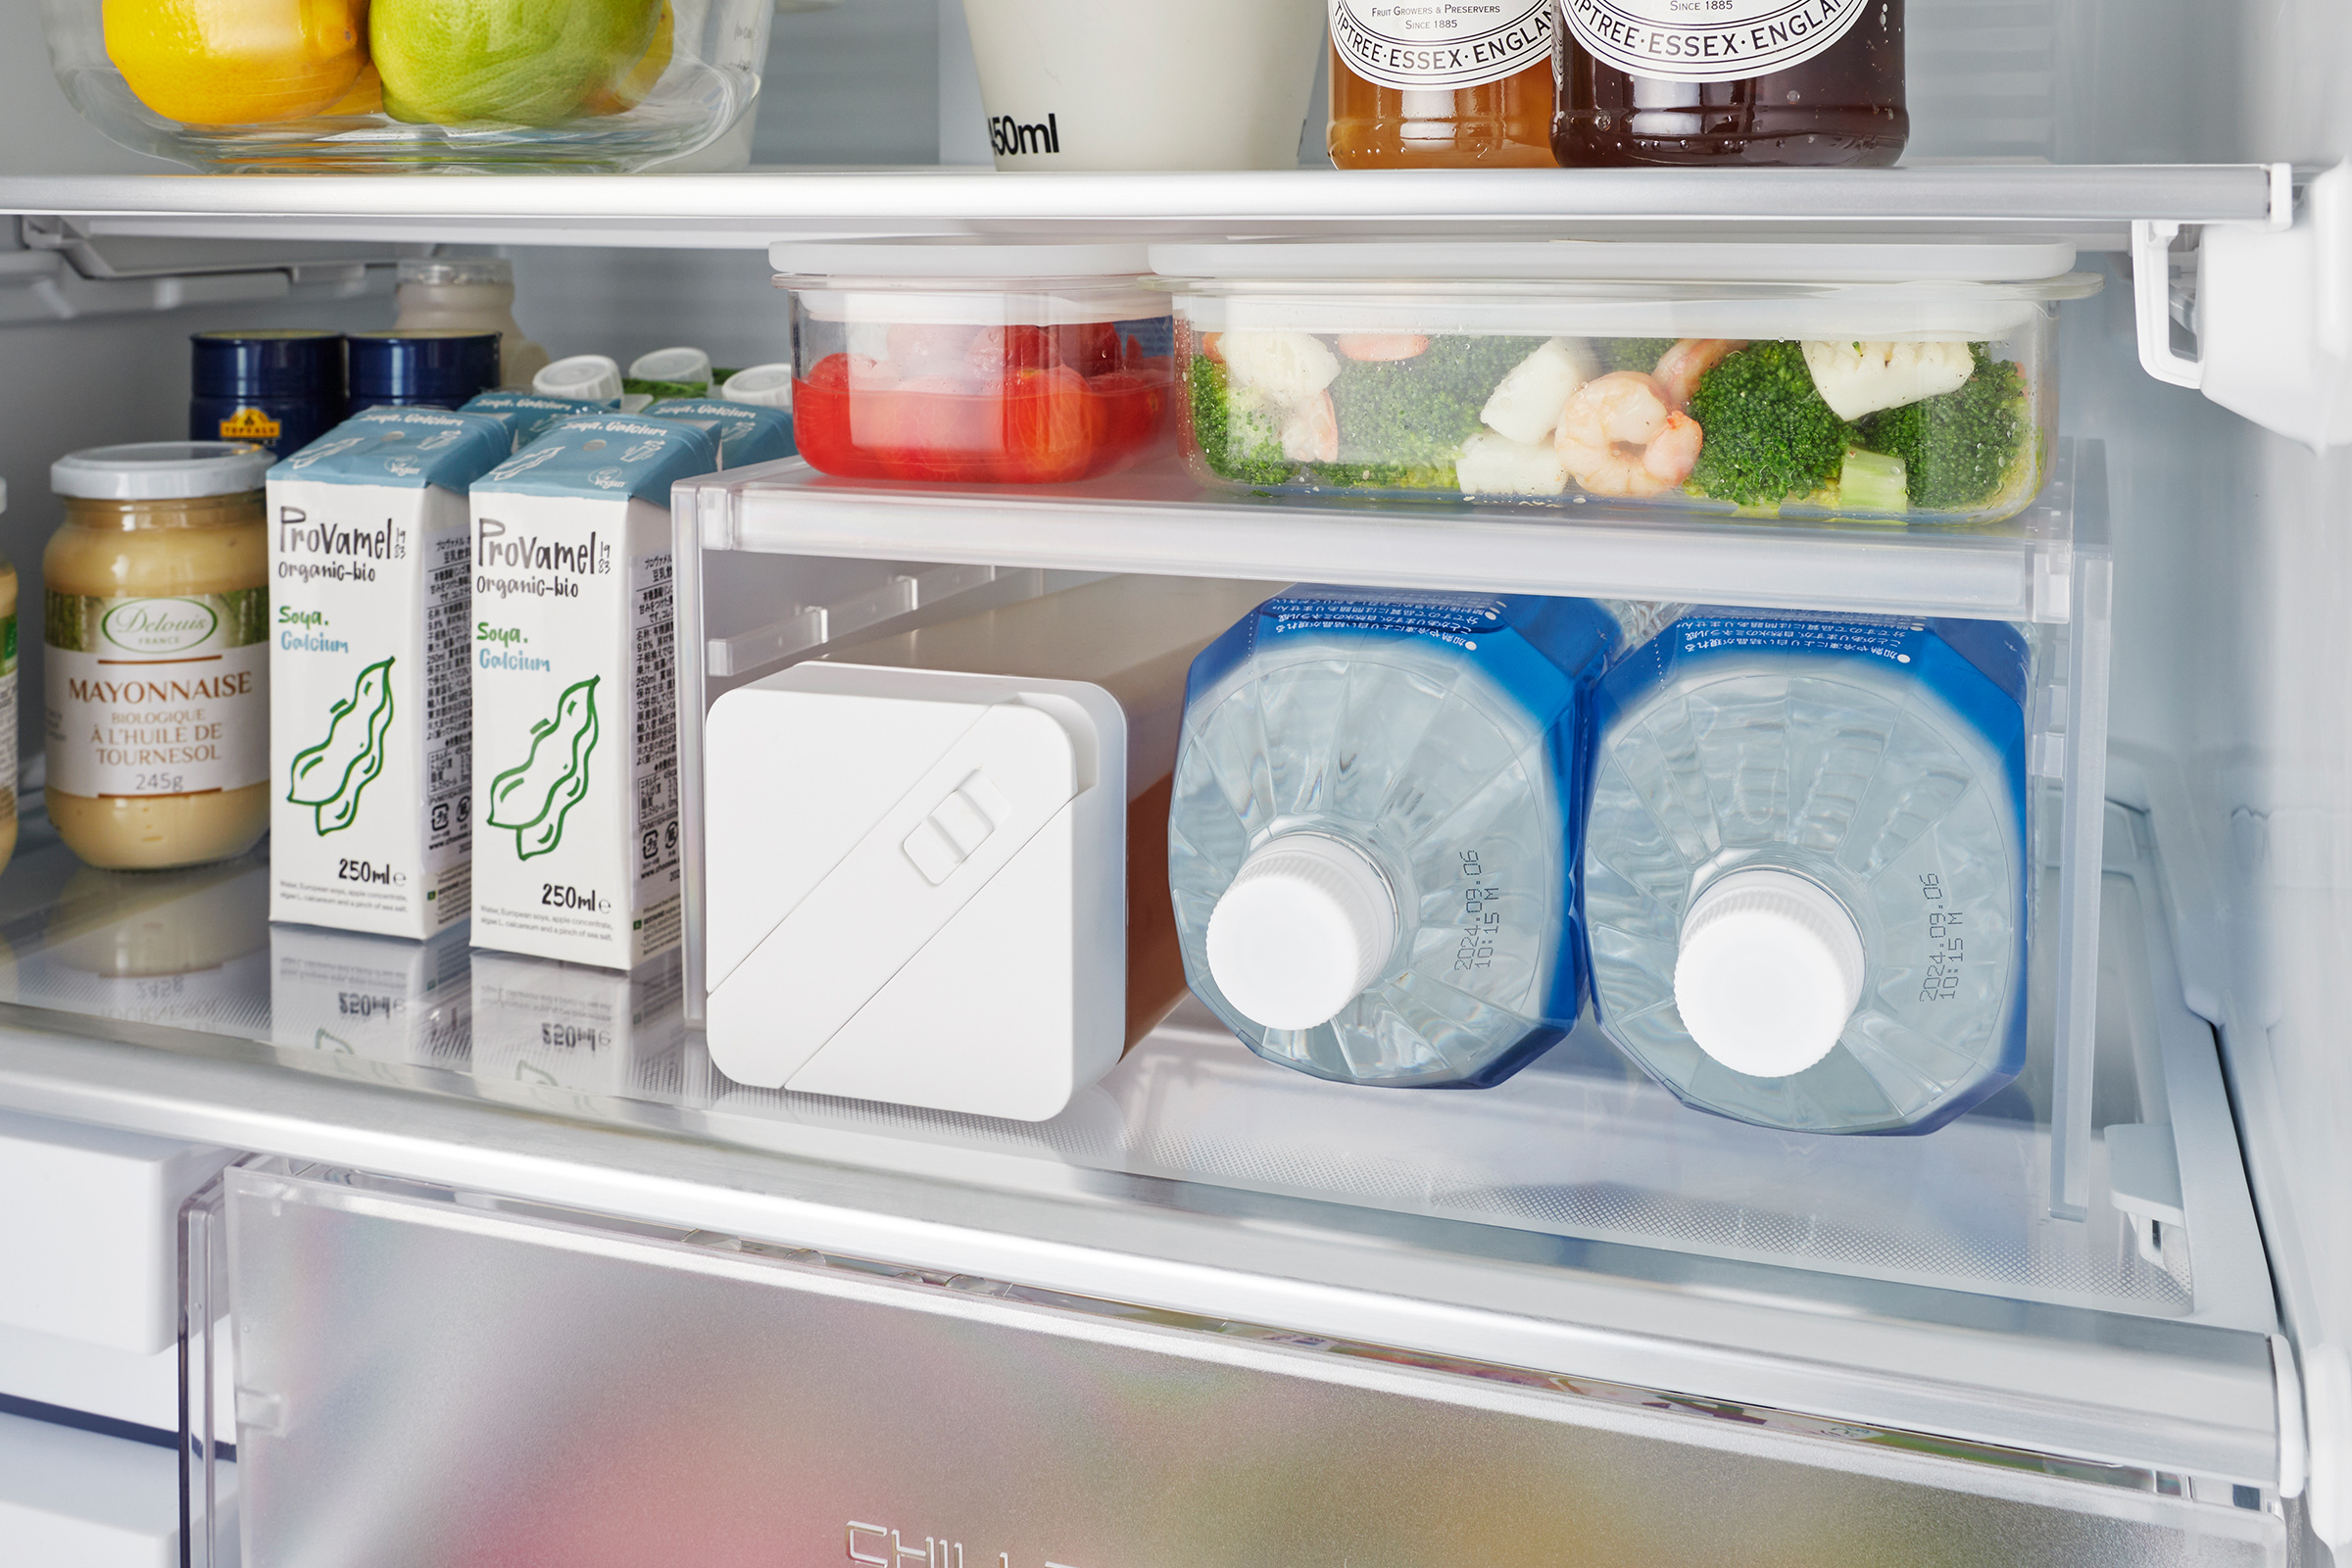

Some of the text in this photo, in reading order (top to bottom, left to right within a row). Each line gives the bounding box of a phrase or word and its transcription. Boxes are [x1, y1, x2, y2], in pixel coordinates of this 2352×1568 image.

[1705, 0, 1733, 11] 1885
[1435, 19, 1458, 29] 1885
[137, 635, 179, 646] FRANCE
[280, 630, 349, 654] Calcium
[479, 647, 551, 672] Calcium
[68, 671, 253, 705] MAYONNAISE
[111, 709, 206, 726] BIOLOGIQUE
[194, 722, 222, 741] DE
[95, 745, 222, 766] TOURNESOL
[135, 772, 184, 793] 245g
[338, 858, 390, 885] 250ml
[541, 883, 596, 911] 250ml
[1454, 850, 1482, 970] 2024.09.06
[1475, 888, 1499, 968] 10:15 M
[1919, 873, 1946, 1002] 2024.09.06
[1939, 912, 1964, 1000] 10:15 M
